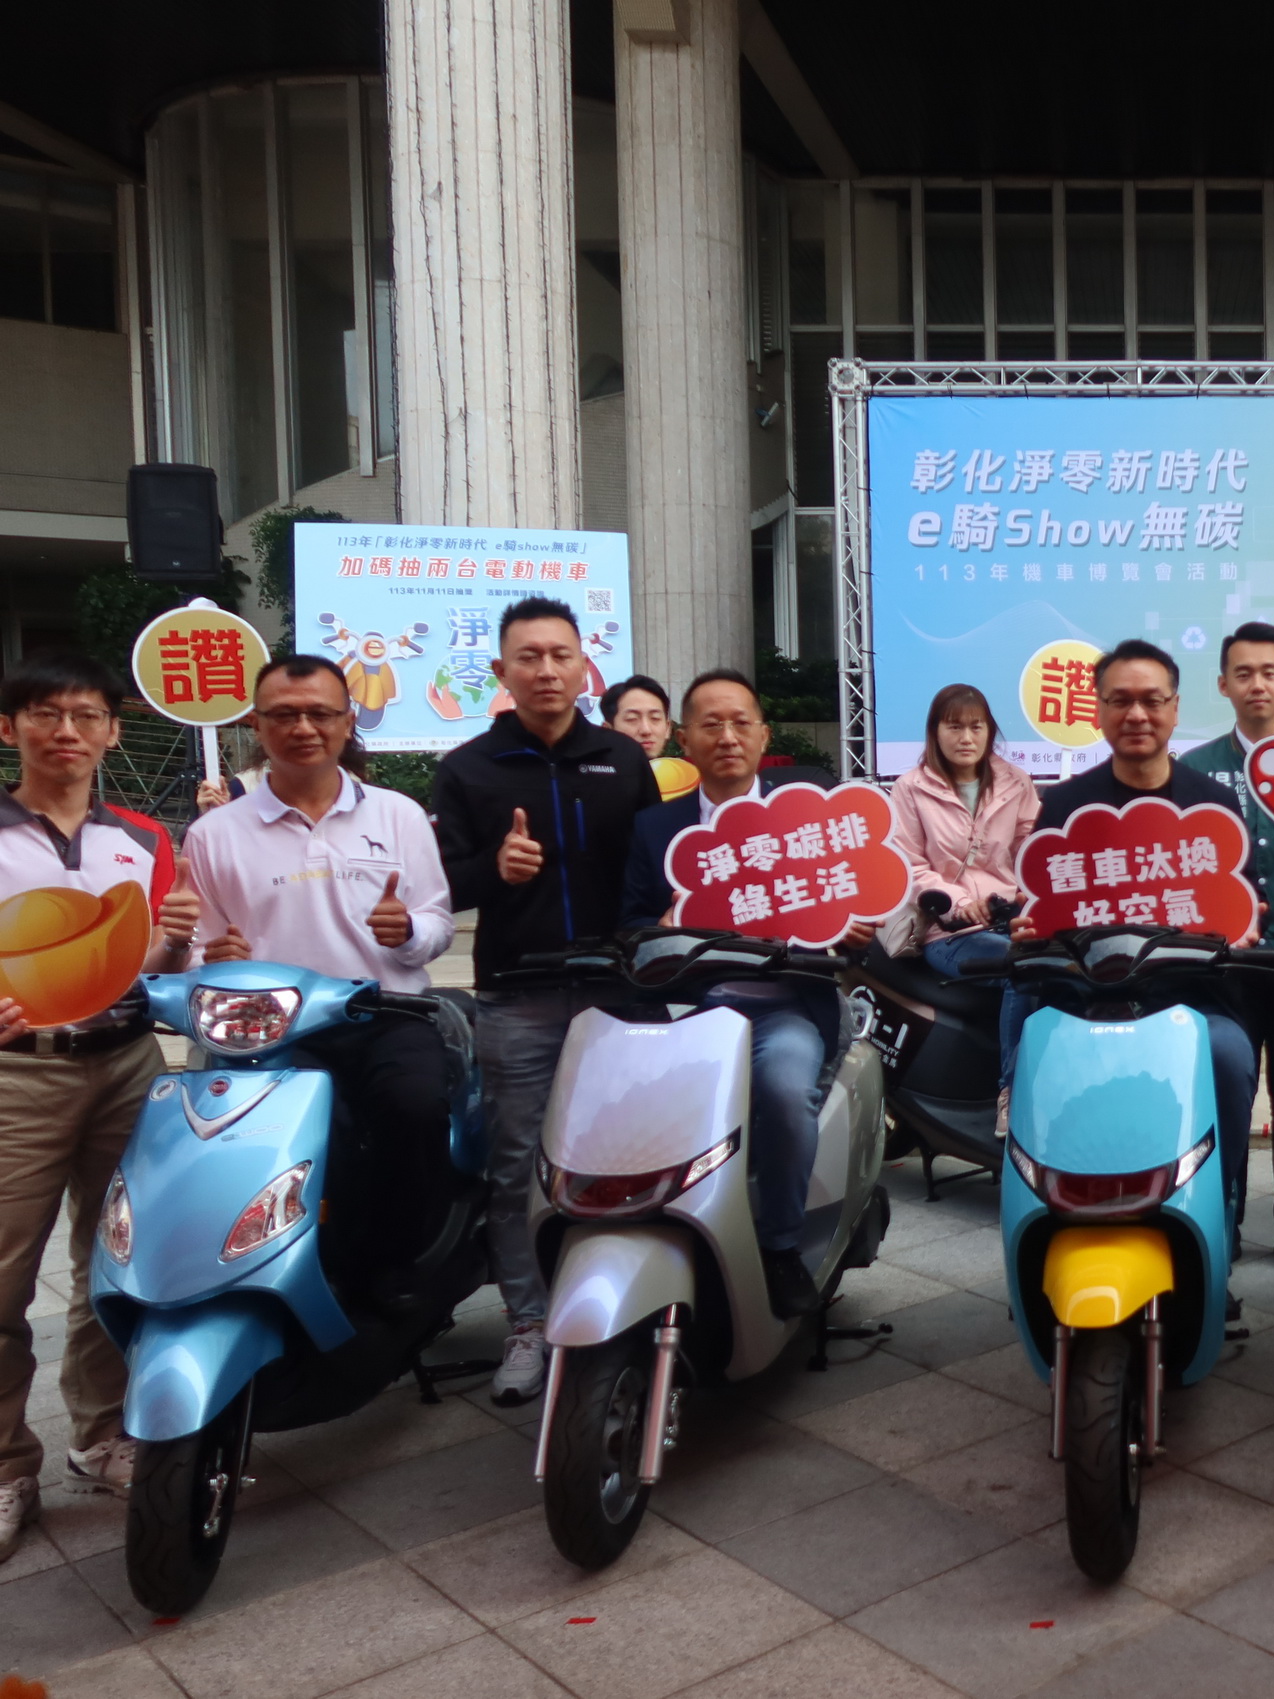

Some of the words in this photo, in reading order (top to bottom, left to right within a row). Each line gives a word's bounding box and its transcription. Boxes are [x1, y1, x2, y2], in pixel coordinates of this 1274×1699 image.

[910, 449, 1249, 493] 彰化淨零新時代
[907, 501, 1245, 551] e騎Show無碳
[337, 556, 590, 582] 加碼抽兩台電動機車
[914, 562, 1239, 582] 113年機車博覽會活動
[158, 629, 248, 705] 讚
[448, 607, 495, 690] 淨零
[696, 812, 871, 886] 淨零碳排
[1046, 835, 1219, 894] 舊車汰換
[727, 861, 860, 925] 綠生活
[1073, 888, 1205, 927] 好空氣
